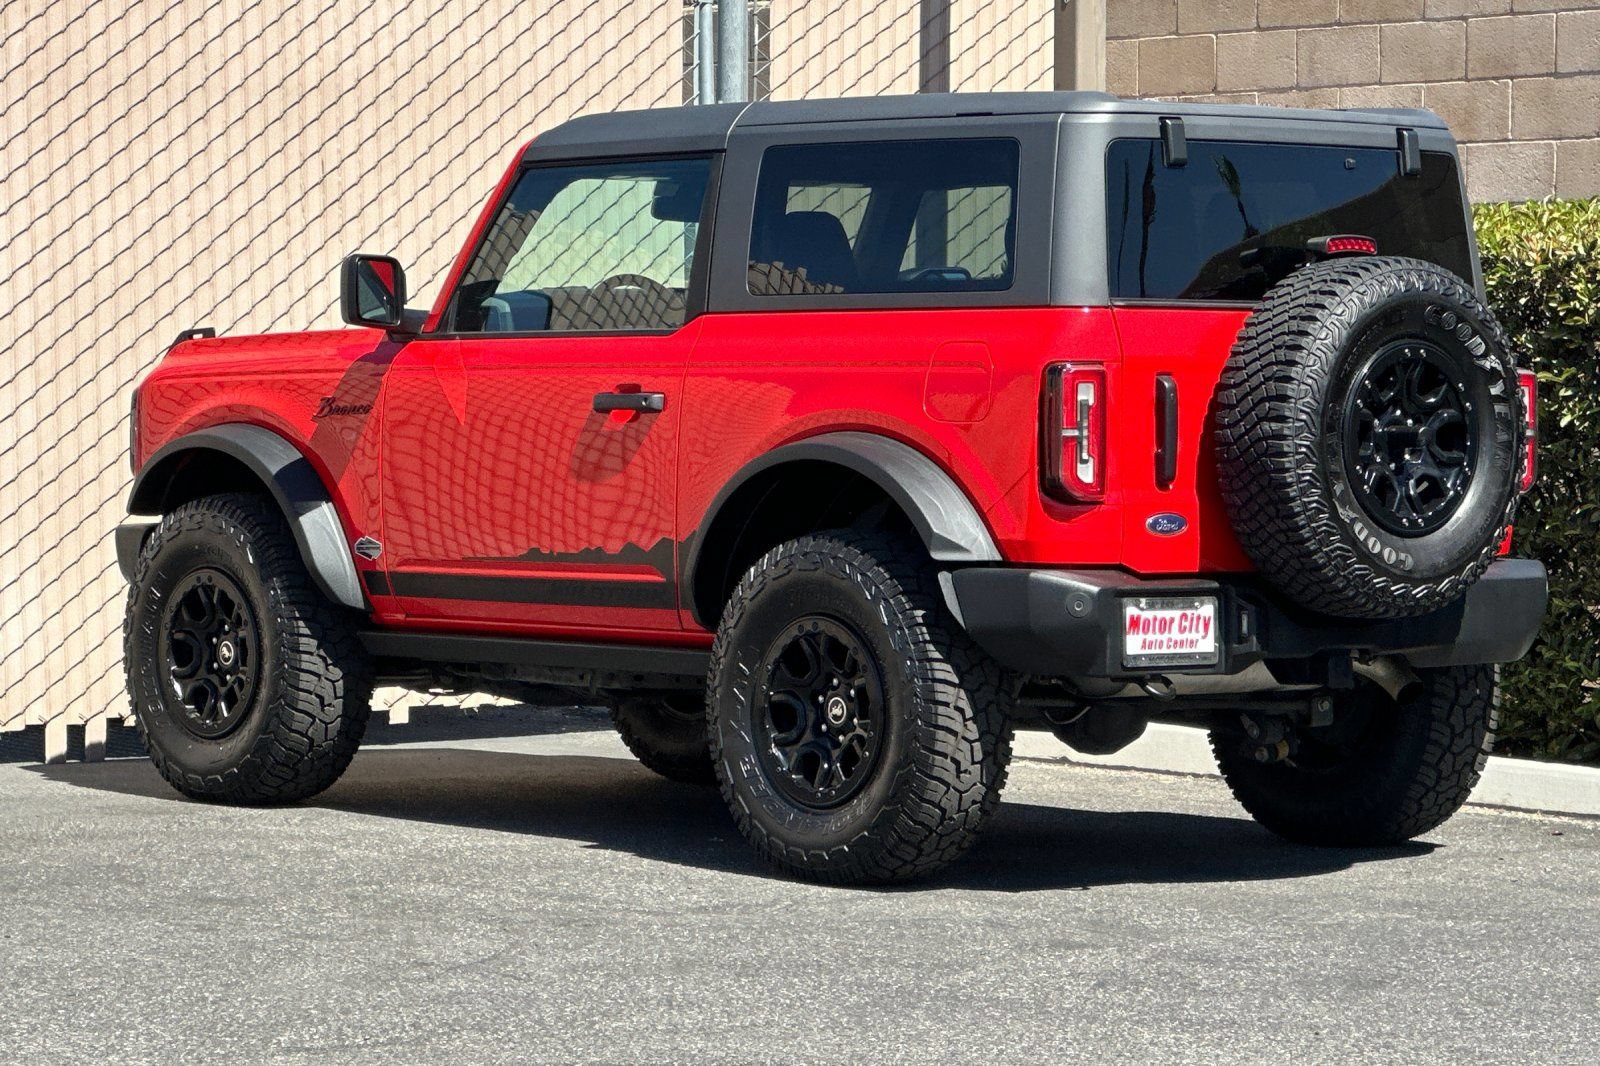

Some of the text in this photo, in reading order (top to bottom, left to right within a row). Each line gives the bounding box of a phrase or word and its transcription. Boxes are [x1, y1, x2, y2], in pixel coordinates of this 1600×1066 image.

[312, 396, 374, 419] Bronco
[1155, 518, 1179, 531] Ford
[1126, 612, 1211, 640] Motor City
[1141, 637, 1199, 650] Auto Center
